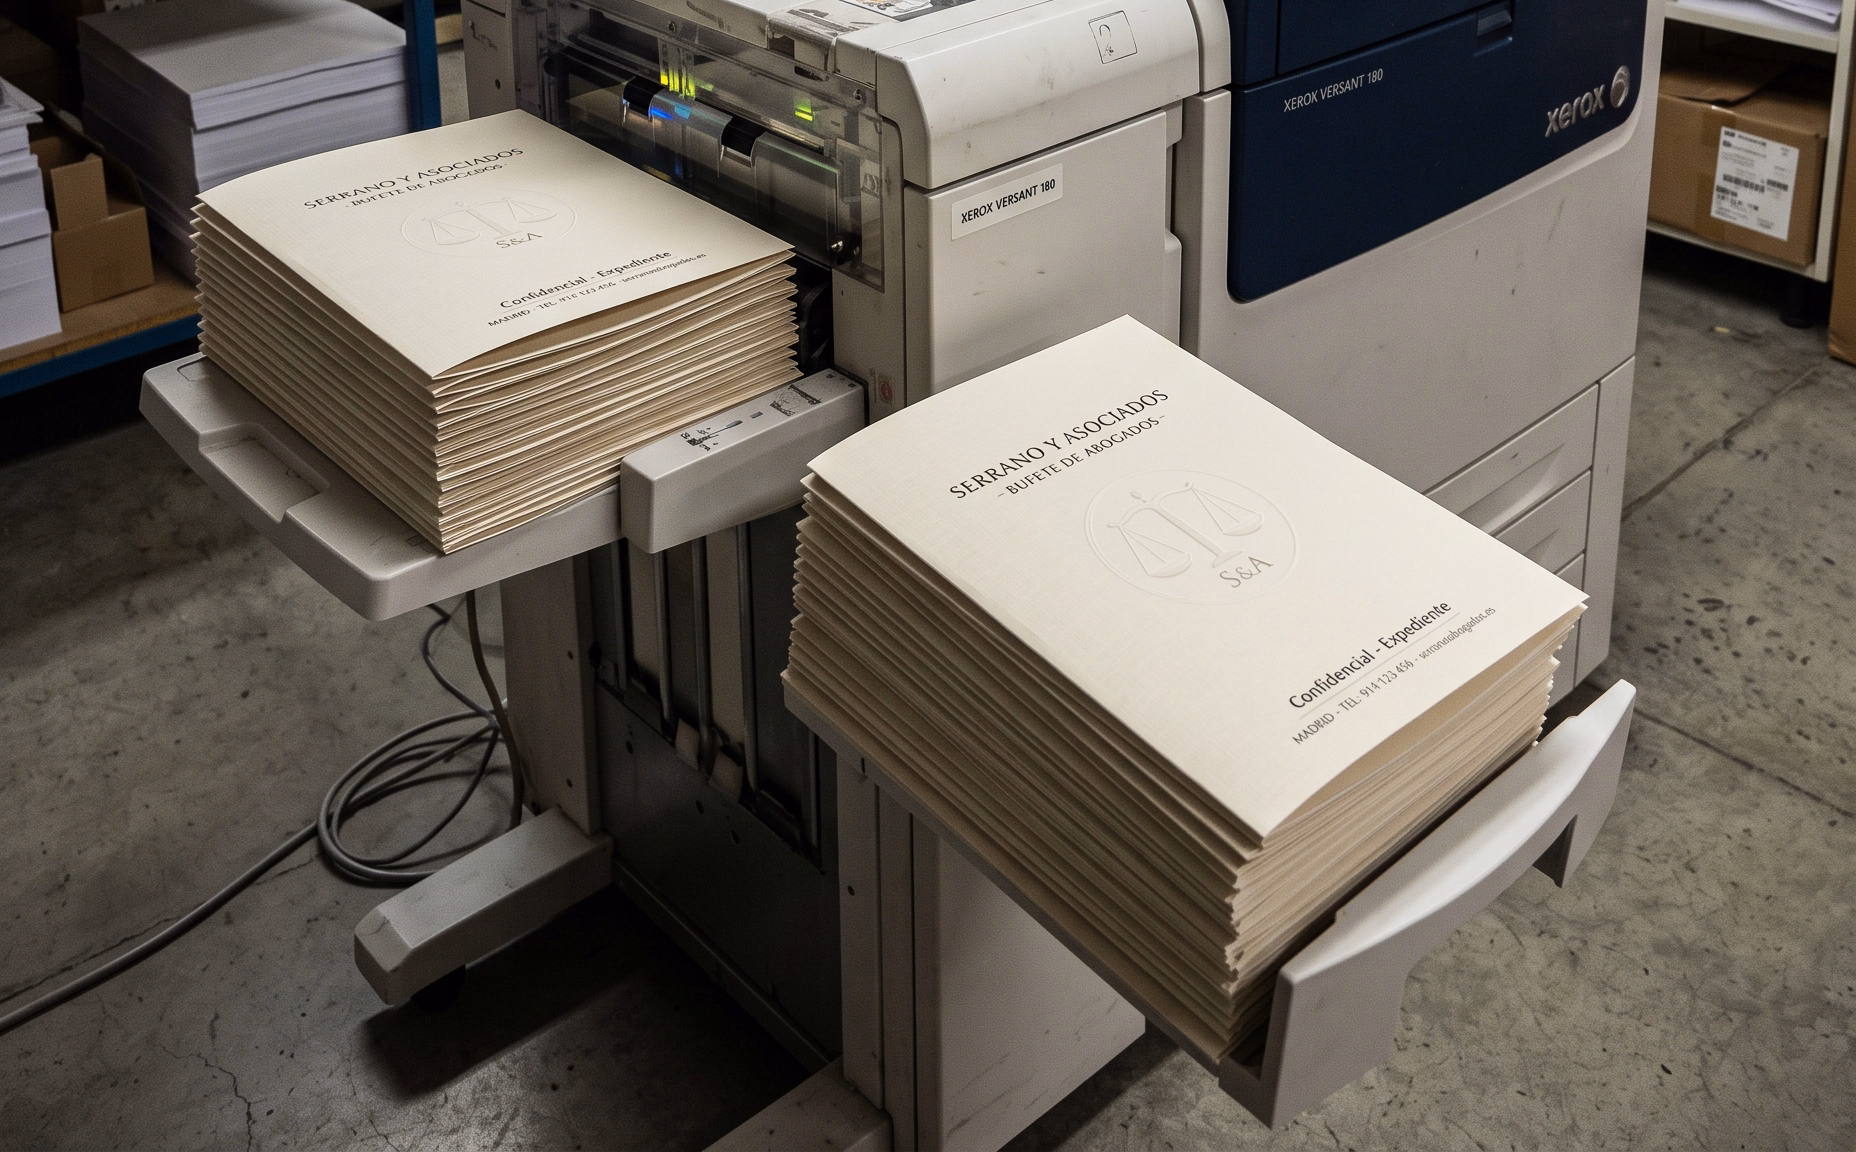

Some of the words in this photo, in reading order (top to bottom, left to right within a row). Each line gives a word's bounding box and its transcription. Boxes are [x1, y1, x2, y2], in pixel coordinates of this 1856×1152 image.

[1283, 90, 1318, 112] XEROX
[1320, 74, 1365, 100] VERSANT
[1367, 68, 1384, 84] 180
[1545, 84, 1605, 138] xerox
[304, 180, 396, 209] SERRANO
[417, 148, 524, 179] ASOCIADOS
[961, 202, 993, 224] XEROX
[996, 184, 1038, 210] VERSANT
[1040, 179, 1056, 193] 180
[950, 446, 1045, 498] SERRANO
[1042, 437, 1062, 450] Y
[1063, 389, 1169, 445] ASOCIADOS
[1005, 463, 1062, 495] BUFETE
[1060, 452, 1084, 468] DE
[1084, 416, 1160, 457] ABOGADOS
[1219, 556, 1274, 588] S&A
[1289, 648, 1376, 708] Confidencial
[1378, 600, 1452, 650] Expediente
